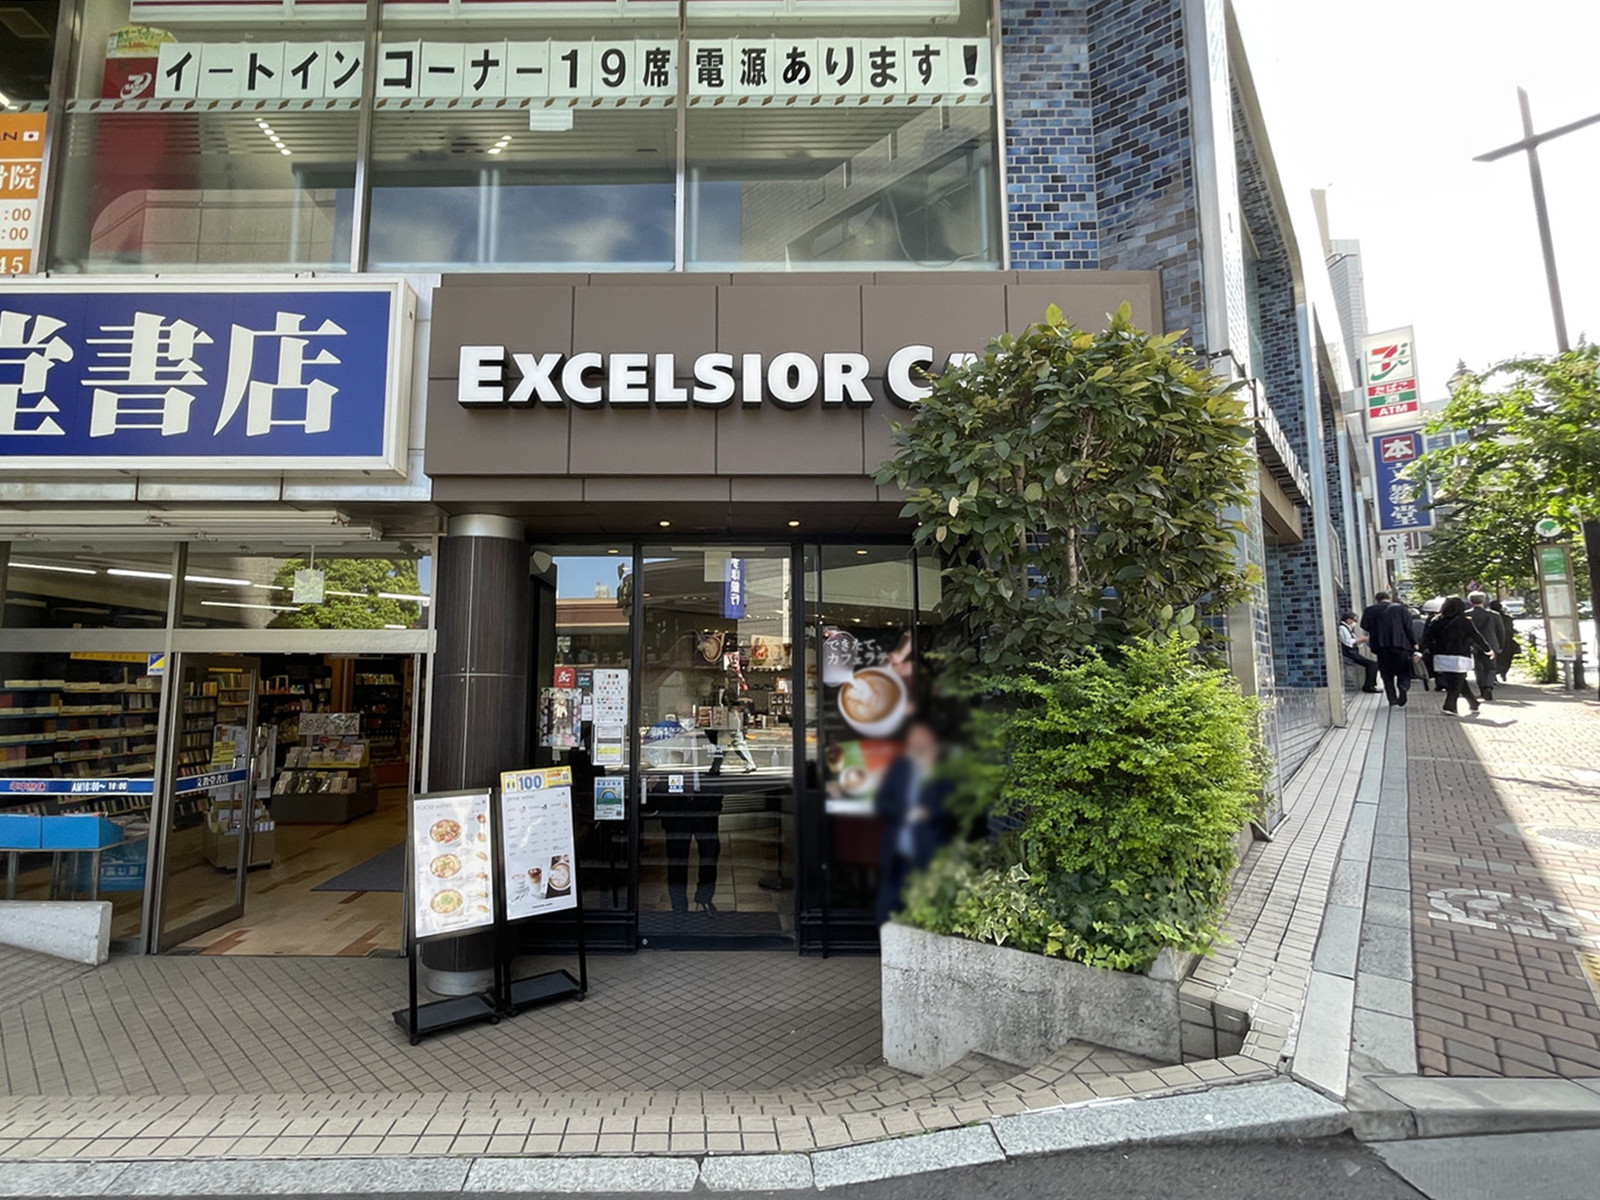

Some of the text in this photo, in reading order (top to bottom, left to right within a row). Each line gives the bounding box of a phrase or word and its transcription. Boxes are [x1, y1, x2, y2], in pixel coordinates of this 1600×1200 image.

[0, 310, 347, 438] 堂書店
[458, 345, 874, 404] EXCELSIOR
[1379, 404, 1407, 416] ATM
[1384, 439, 1413, 458] 本
[519, 775, 542, 790] 100
